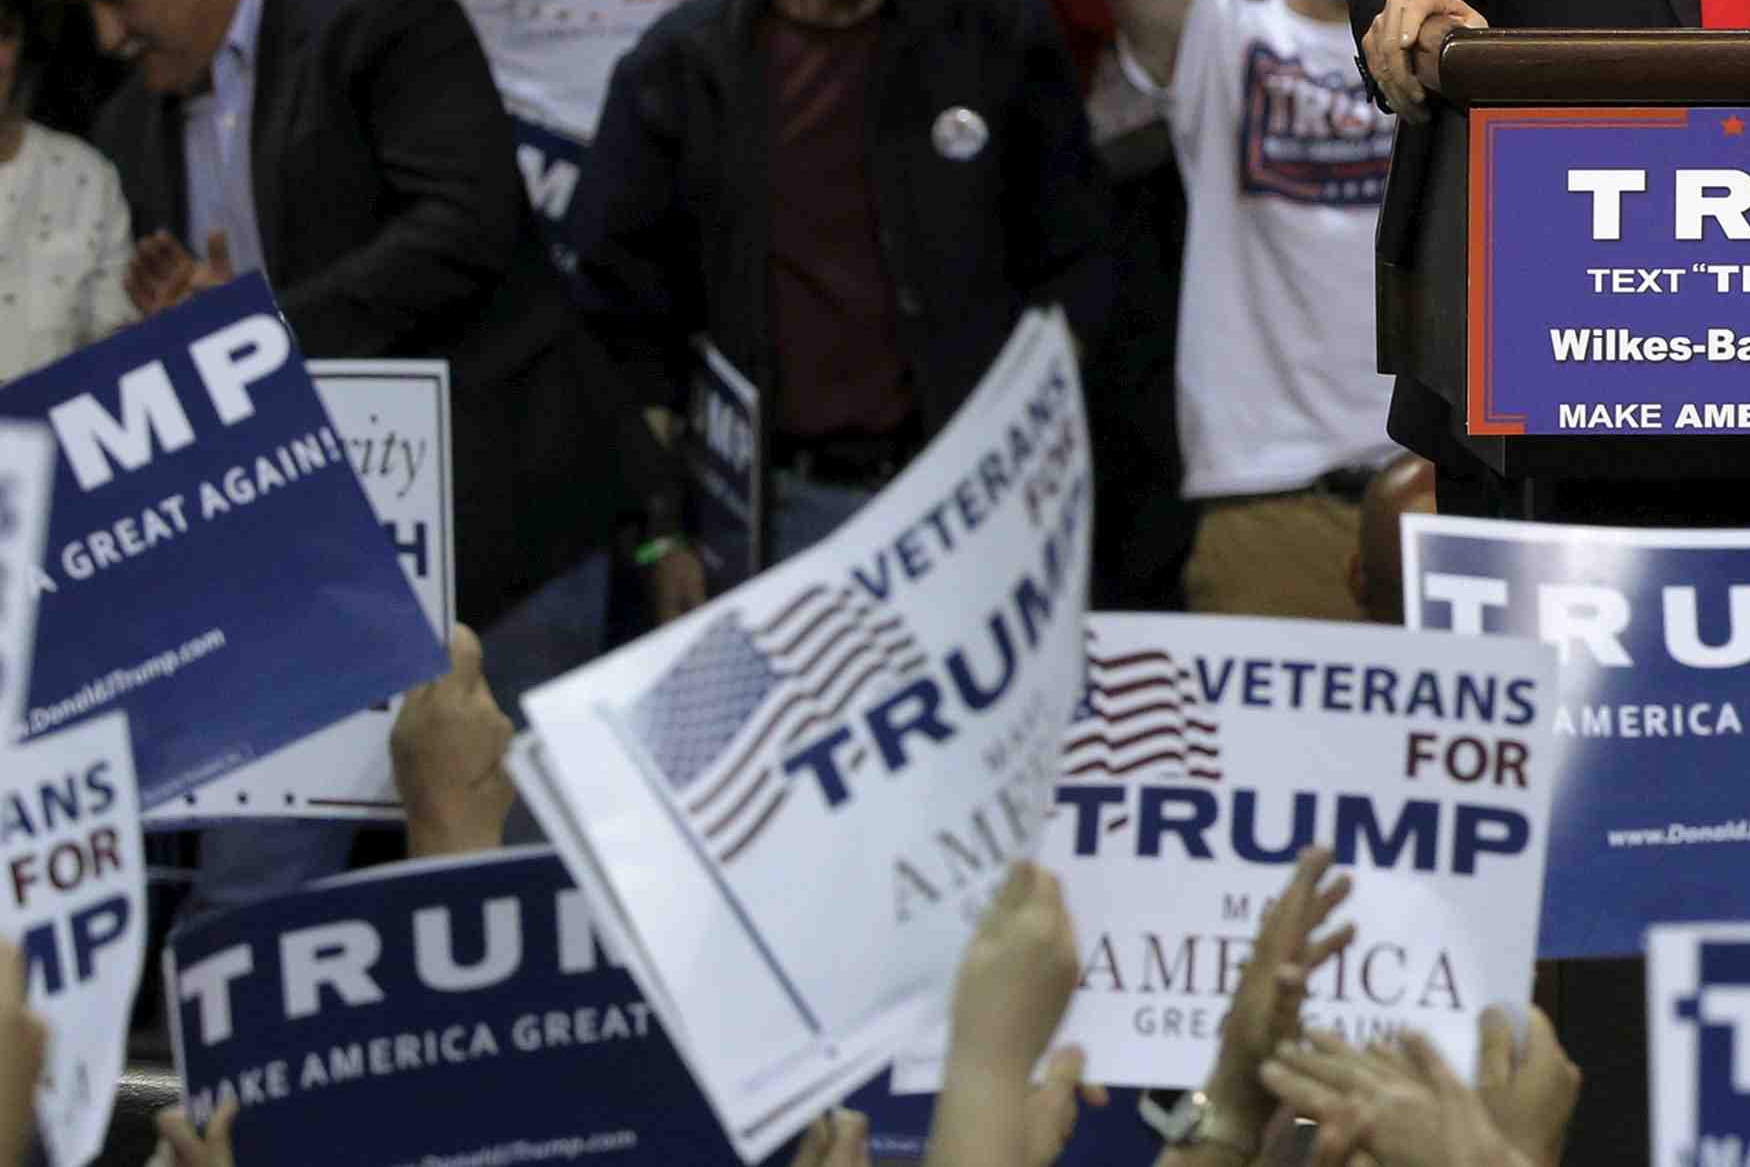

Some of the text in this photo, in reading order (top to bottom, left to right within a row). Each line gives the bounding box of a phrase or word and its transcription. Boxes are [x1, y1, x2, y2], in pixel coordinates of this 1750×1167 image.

[1587, 268, 1686, 293] TEXT
[48, 313, 292, 492] MP
[1558, 405, 1662, 429] MAKE
[61, 425, 341, 580] GREAT AGAIN!
[346, 434, 427, 498] rity
[851, 370, 1067, 604] VETERANS
[1197, 657, 1536, 725] VETERANS
[1553, 700, 1743, 738] AMERICA
[1406, 733, 1530, 788] FOR
[11, 826, 122, 907] FOR
[1055, 784, 1531, 876] TRUMP
[178, 889, 628, 1046] TRU
[1079, 932, 1466, 1011] AMEICA
[300, 1021, 499, 1090] AMERICA
[511, 1000, 653, 1052] GREAT
[1133, 1005, 1216, 1036] GRE
